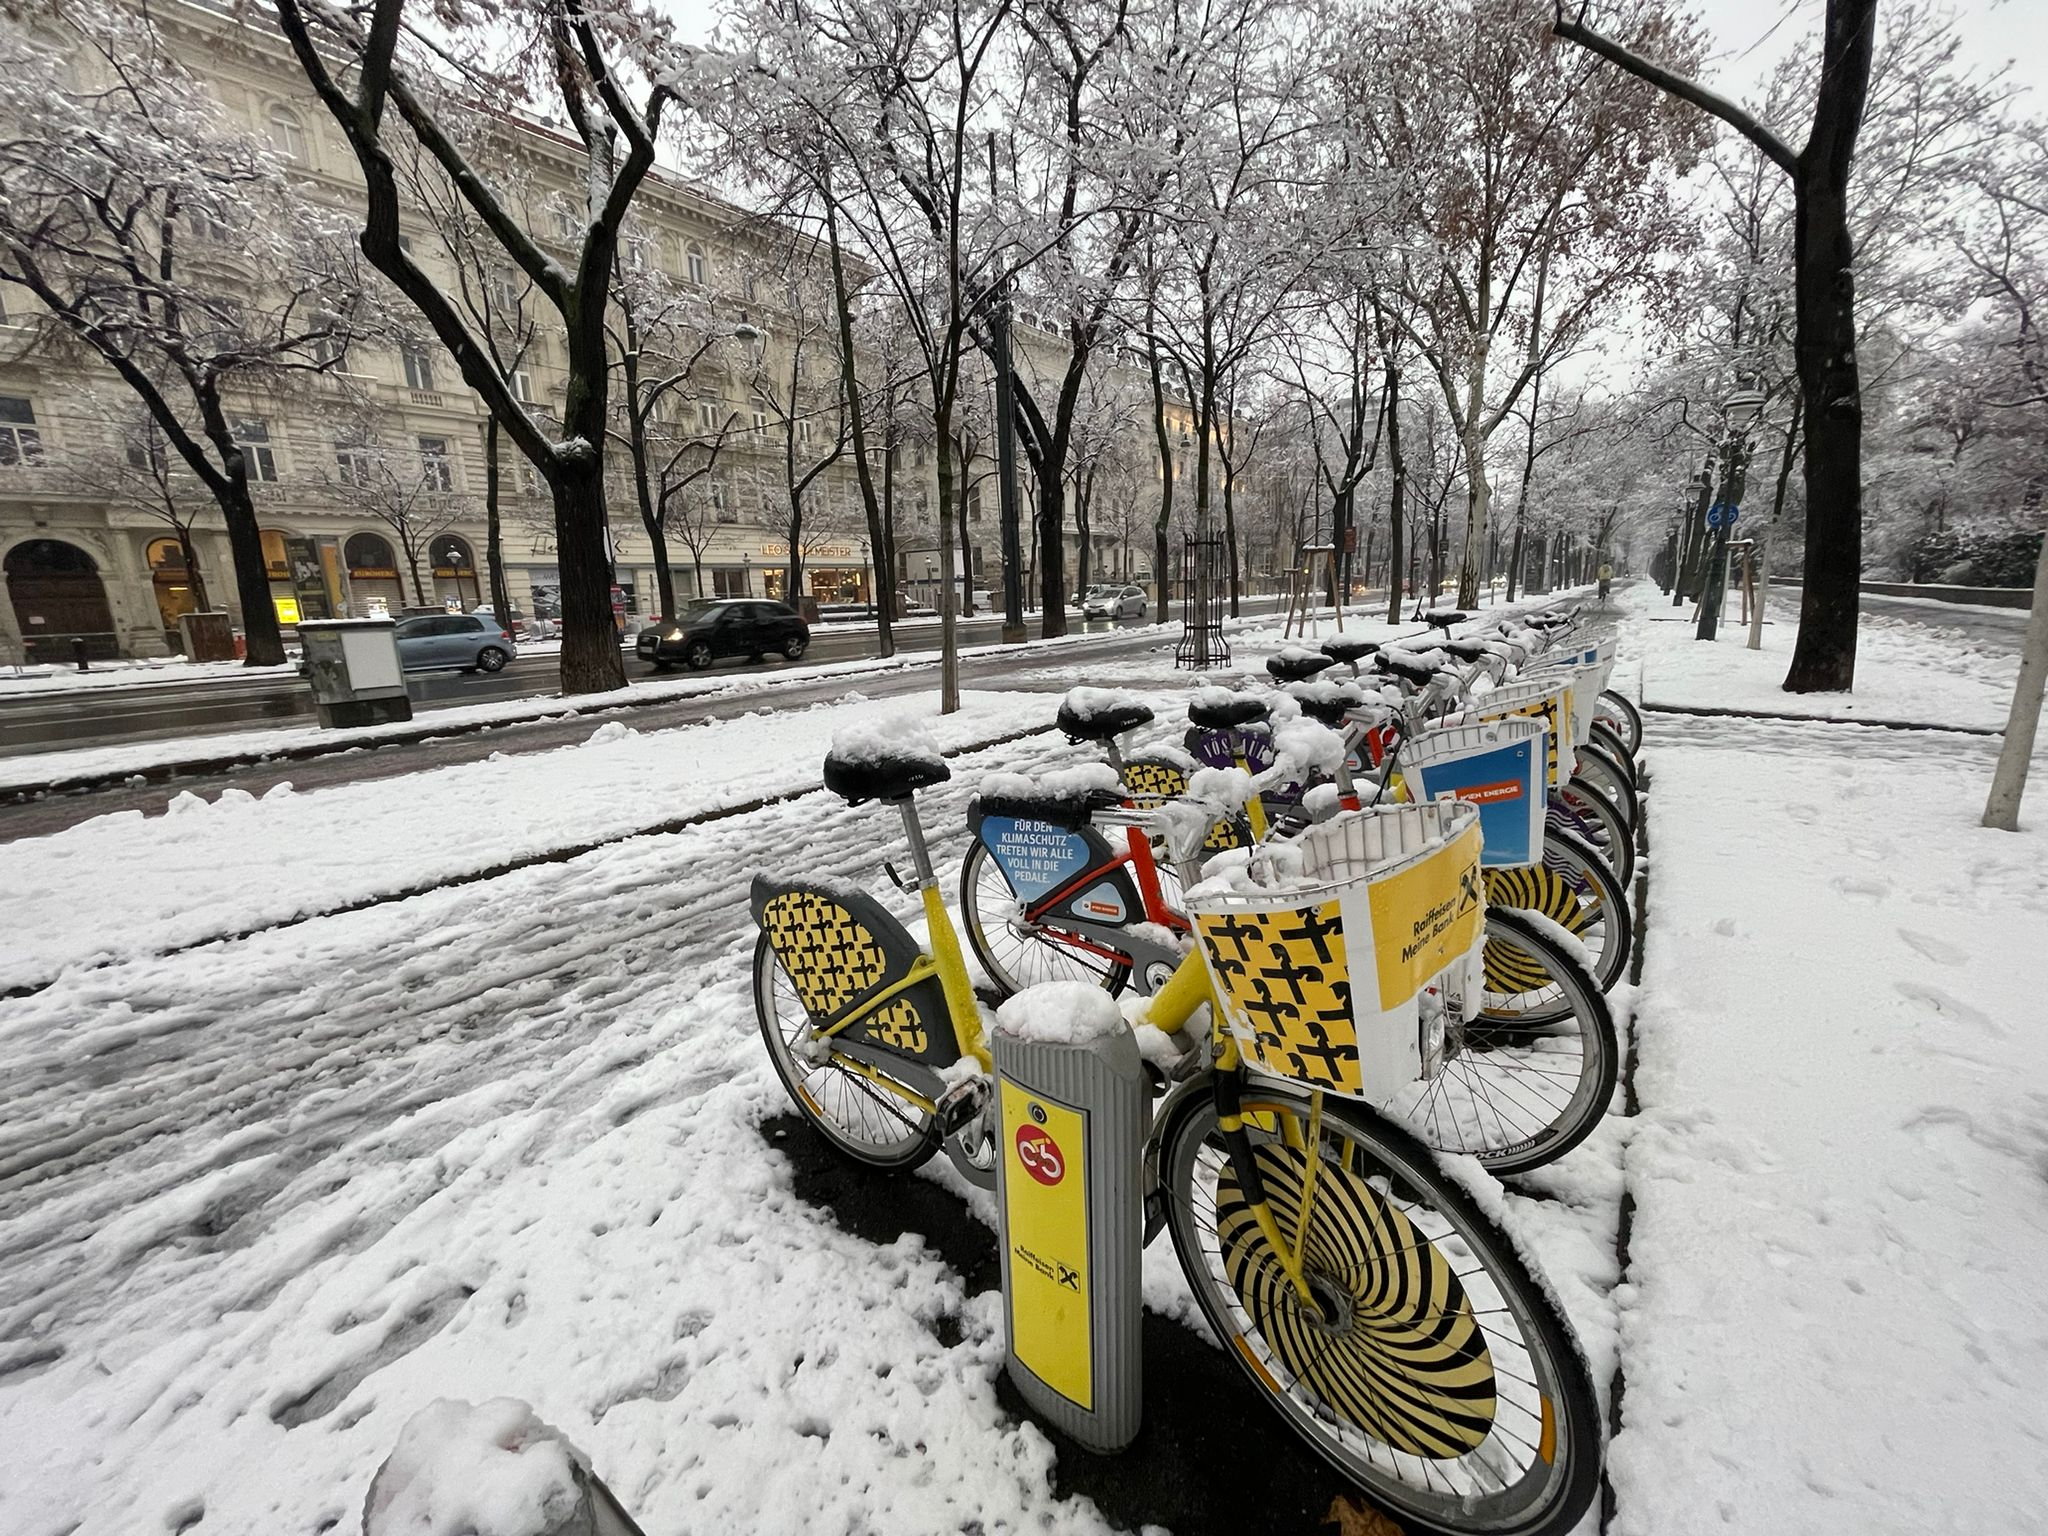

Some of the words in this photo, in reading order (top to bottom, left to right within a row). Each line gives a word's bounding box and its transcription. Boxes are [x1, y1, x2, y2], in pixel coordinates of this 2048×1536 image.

[761, 544, 783, 556] LEO
[1483, 785, 1519, 798] ENERGIE
[1014, 818, 1031, 832] FÜR
[1033, 820, 1053, 833] DEN
[1001, 833, 1067, 847] KLIMASCHUTZ
[996, 844, 1028, 857] TRETEN
[1029, 846, 1048, 859] WIR
[1050, 847, 1073, 860] ALLE
[1007, 857, 1029, 870] VOLL
[1032, 859, 1042, 871] IN
[1043, 860, 1059, 872] DIE
[1014, 871, 1051, 884] PEDALE.
[1413, 897, 1456, 937] Raiffeisen
[1402, 933, 1430, 964] Meine
[1432, 910, 1454, 938] Bank
